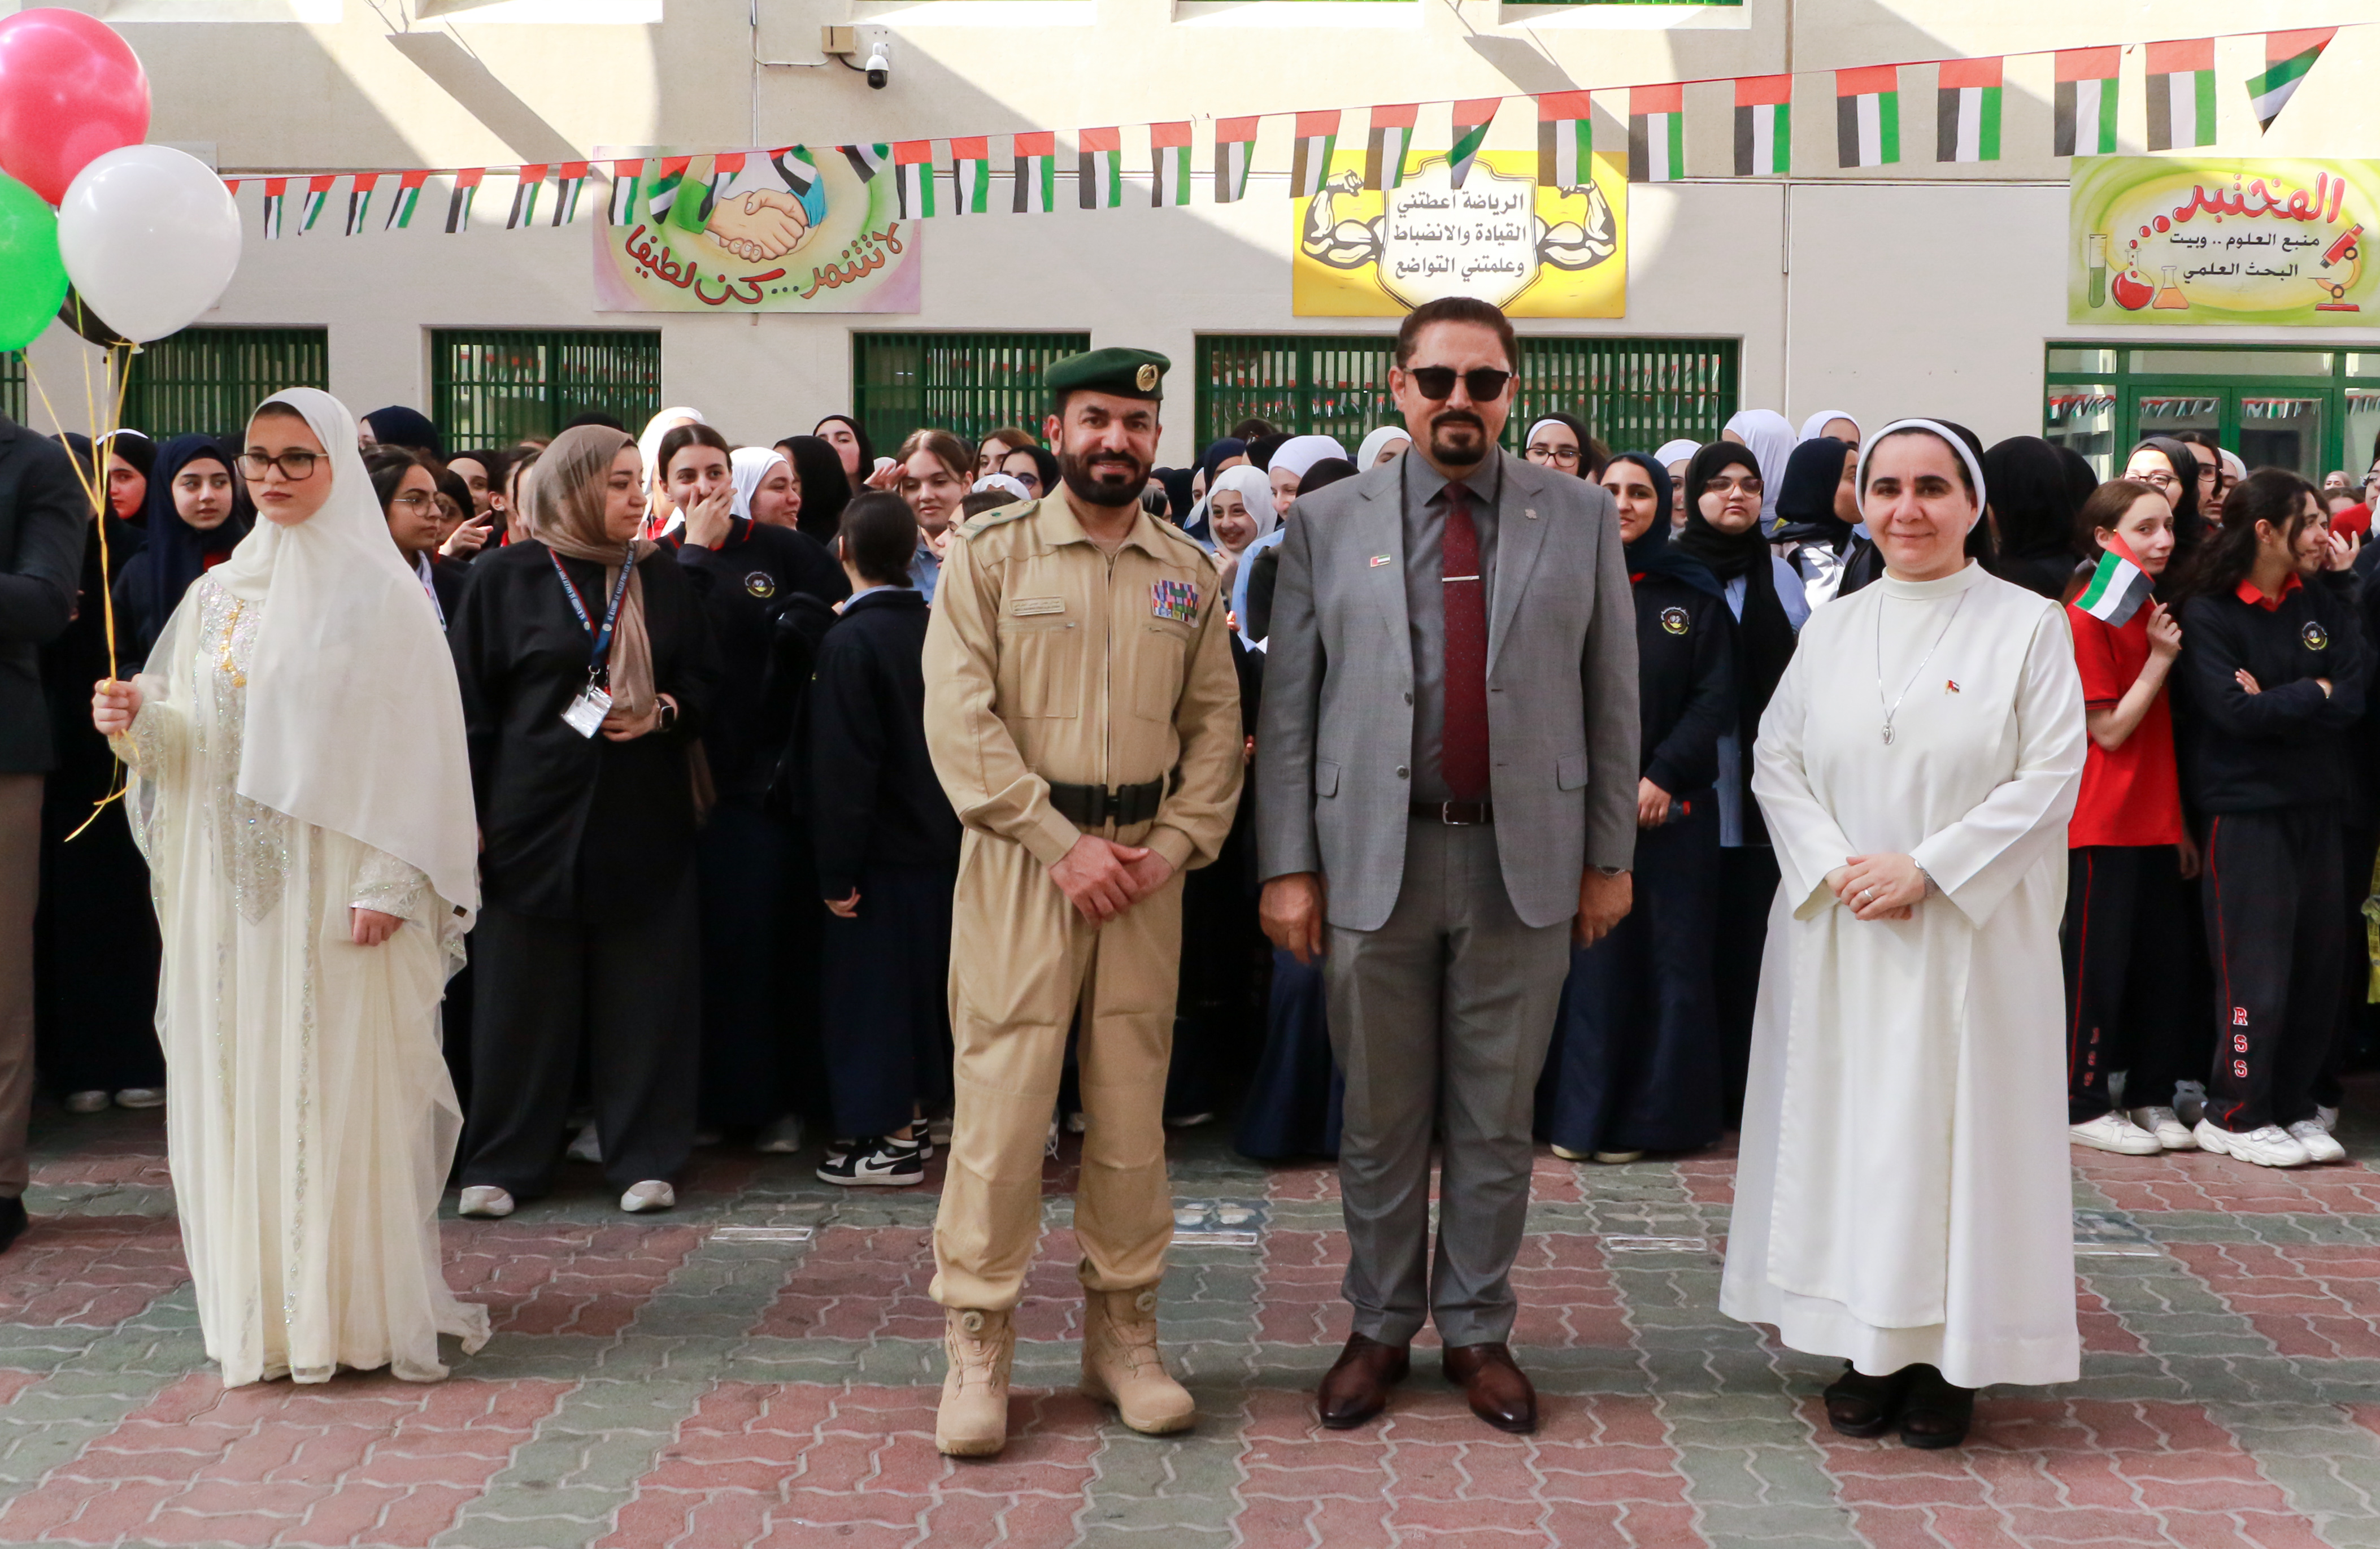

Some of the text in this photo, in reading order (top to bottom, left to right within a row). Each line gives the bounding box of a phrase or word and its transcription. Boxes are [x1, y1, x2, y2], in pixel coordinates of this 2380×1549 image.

[1397, 189, 1524, 219] الرياضة أعطتني
[2172, 172, 2345, 223] المختبر
[872, 222, 903, 254] لا
[1394, 223, 1526, 246] القيادة والانضباط
[2170, 233, 2207, 249] وبيت
[2226, 232, 2276, 251] العلوم
[2282, 234, 2320, 252] منبع
[625, 224, 697, 288] لطيفا
[1395, 255, 1524, 282] وعلمتني التواضع
[694, 268, 786, 305] كن
[2183, 262, 2298, 284] البحث العلمي
[2233, 1007, 2248, 1078] RSS
